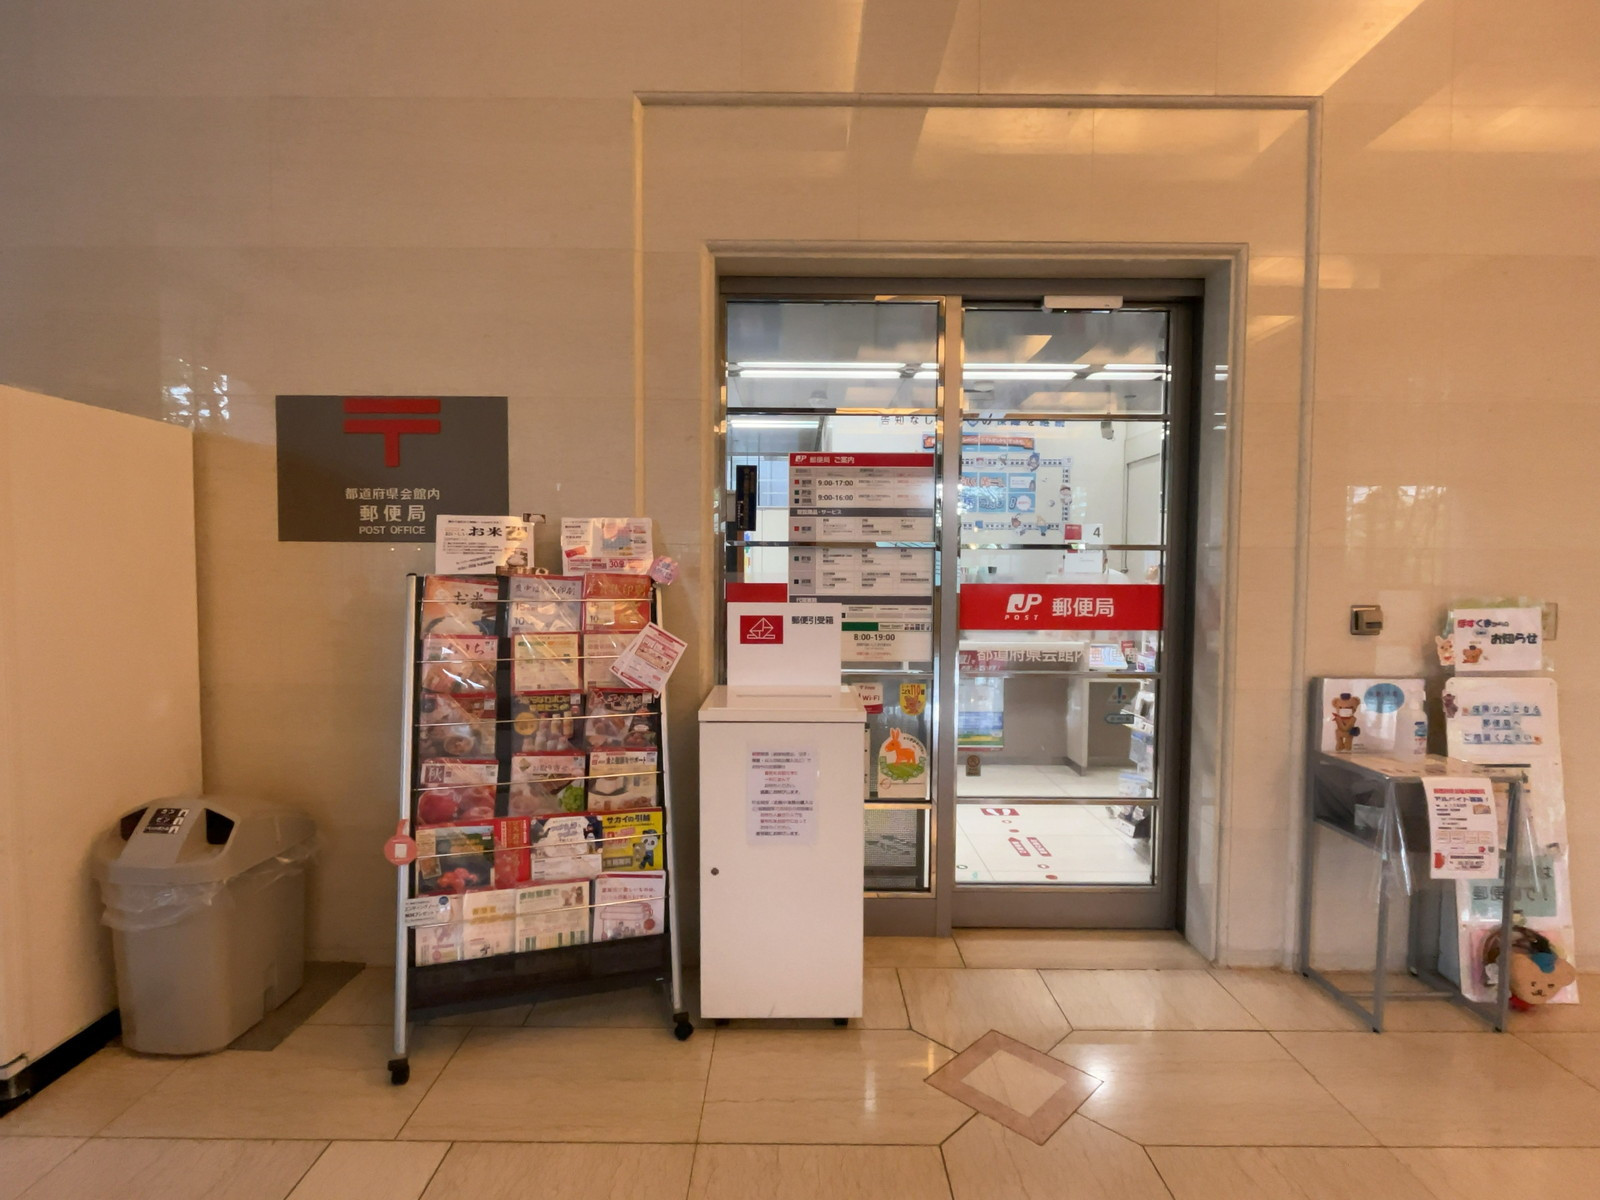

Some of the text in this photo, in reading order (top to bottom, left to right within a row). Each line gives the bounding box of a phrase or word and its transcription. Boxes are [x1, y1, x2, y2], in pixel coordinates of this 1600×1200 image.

[833, 456, 855, 464] ご案内
[817, 479, 854, 487] 9:00-17:00
[345, 487, 440, 501] 都道府県会館内
[817, 493, 854, 501] 9:00-16:00
[359, 504, 426, 523] 郵便局
[359, 525, 426, 535] POST OFFICE
[468, 526, 503, 537] お米
[1093, 526, 1101, 538] 4
[1052, 597, 1115, 618] 郵便局
[791, 615, 834, 625] 郵便引受箱
[853, 633, 896, 642] 8:00-19:00
[1490, 632, 1539, 645] お知らせ
